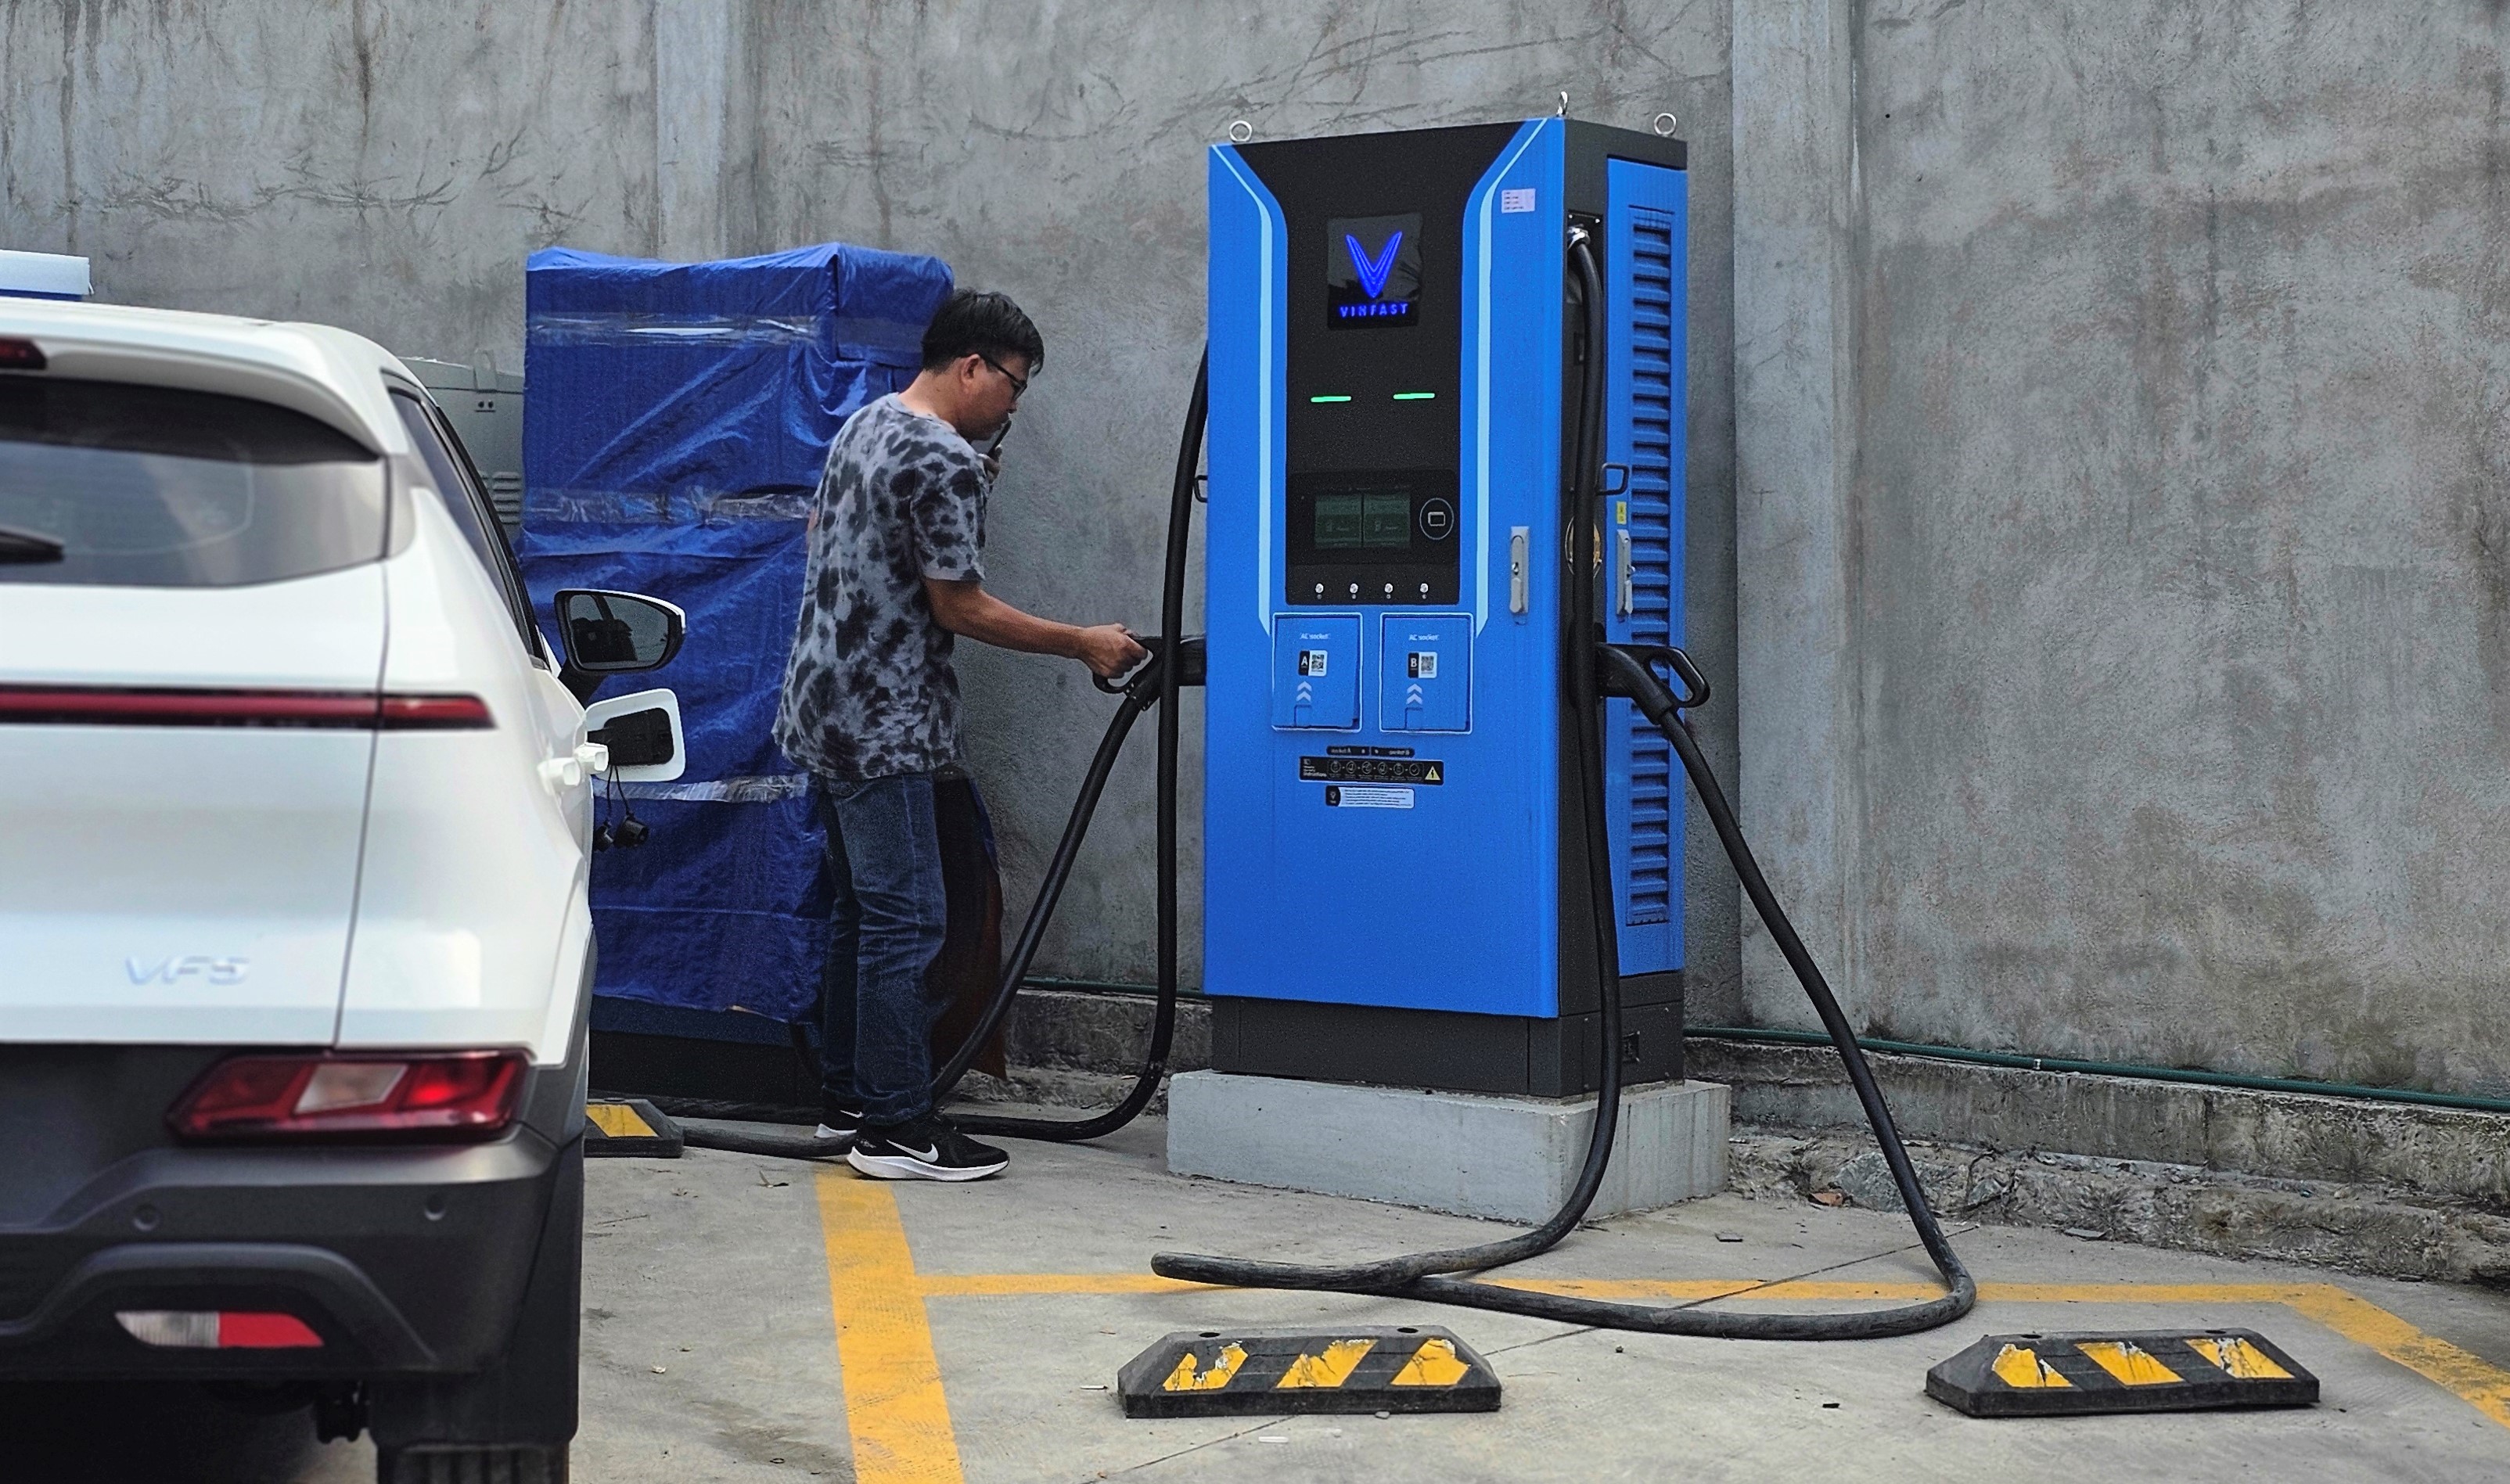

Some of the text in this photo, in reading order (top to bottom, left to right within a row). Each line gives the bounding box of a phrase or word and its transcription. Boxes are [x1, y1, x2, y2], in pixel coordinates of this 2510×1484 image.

[1340, 303, 1408, 318] VINFAST
[1301, 656, 1308, 666] A
[1410, 657, 1418, 667] B
